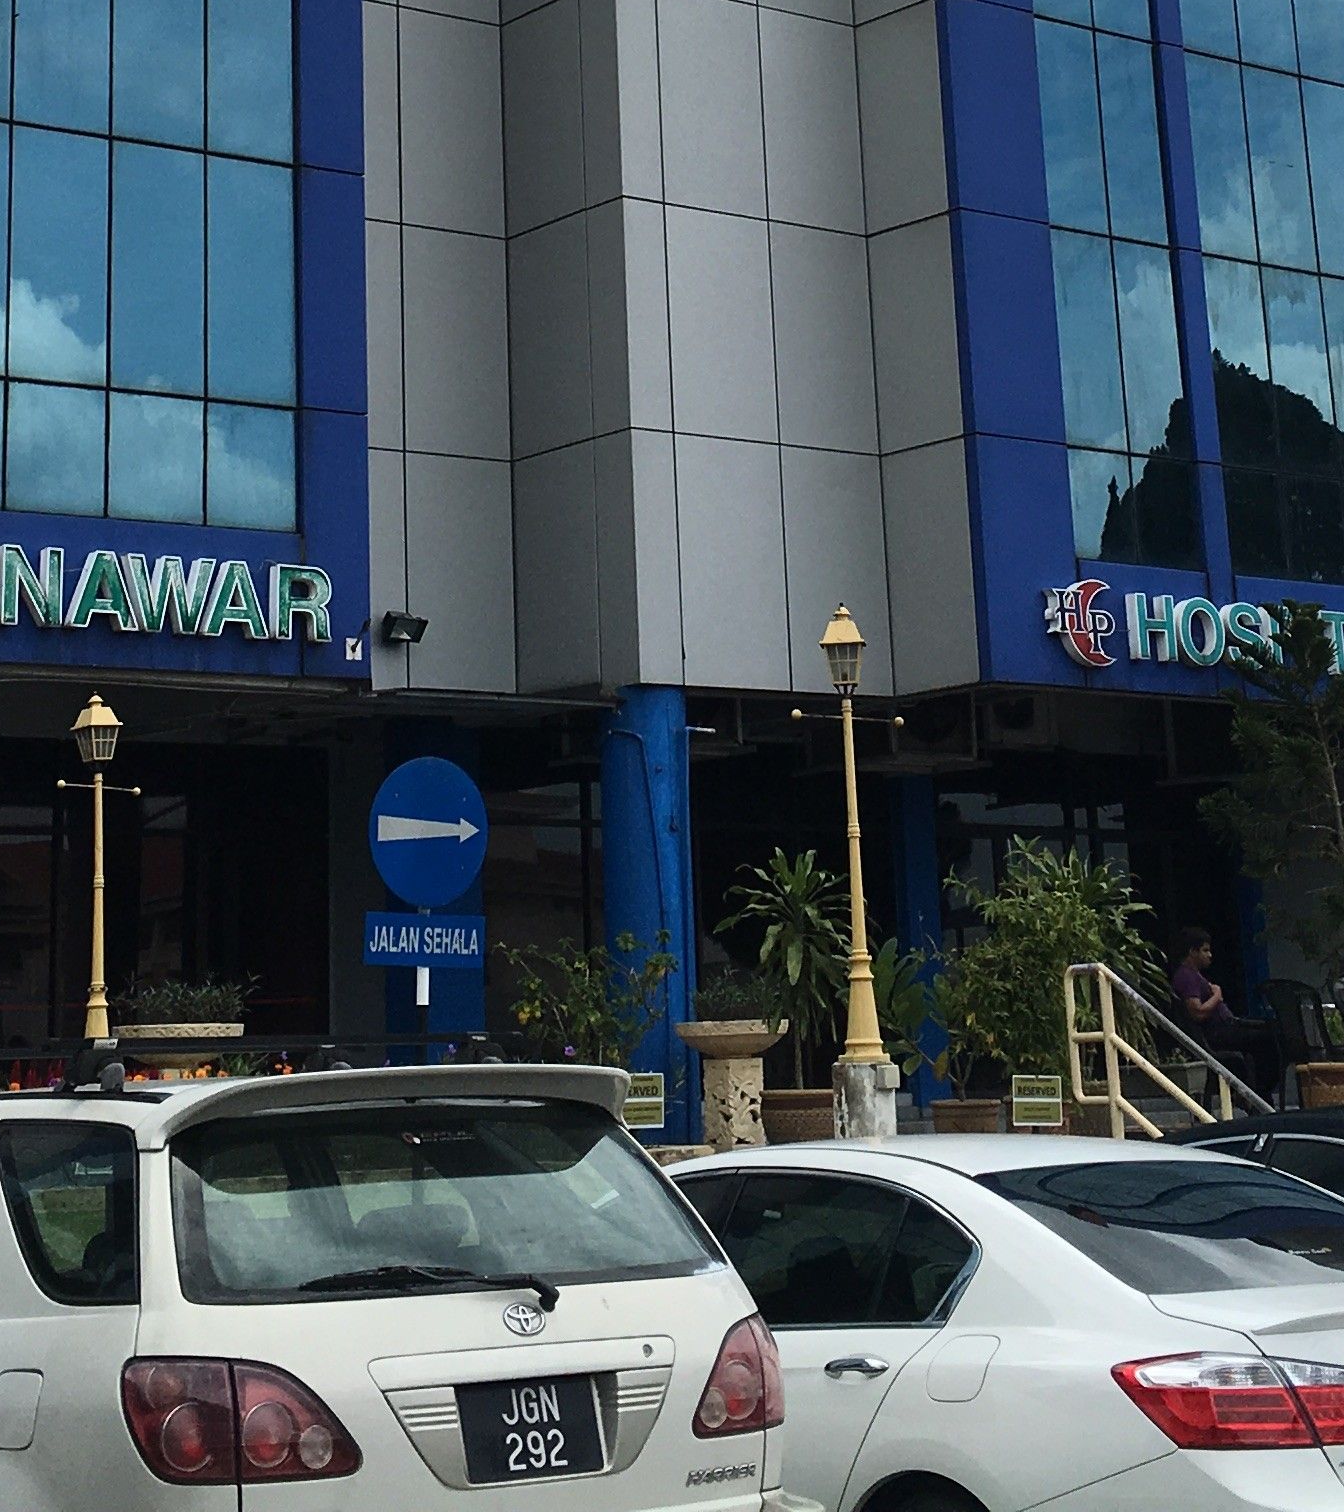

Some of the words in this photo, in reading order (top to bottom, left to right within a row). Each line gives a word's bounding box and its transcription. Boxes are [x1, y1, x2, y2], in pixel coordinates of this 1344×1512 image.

[369, 926, 420, 953] JALAN
[423, 927, 478, 955] SEHALA
[628, 1085, 659, 1096] ERVED
[501, 1384, 561, 1426] JGN
[506, 1428, 569, 1472] 292
[685, 1461, 757, 1488] HARRIER
